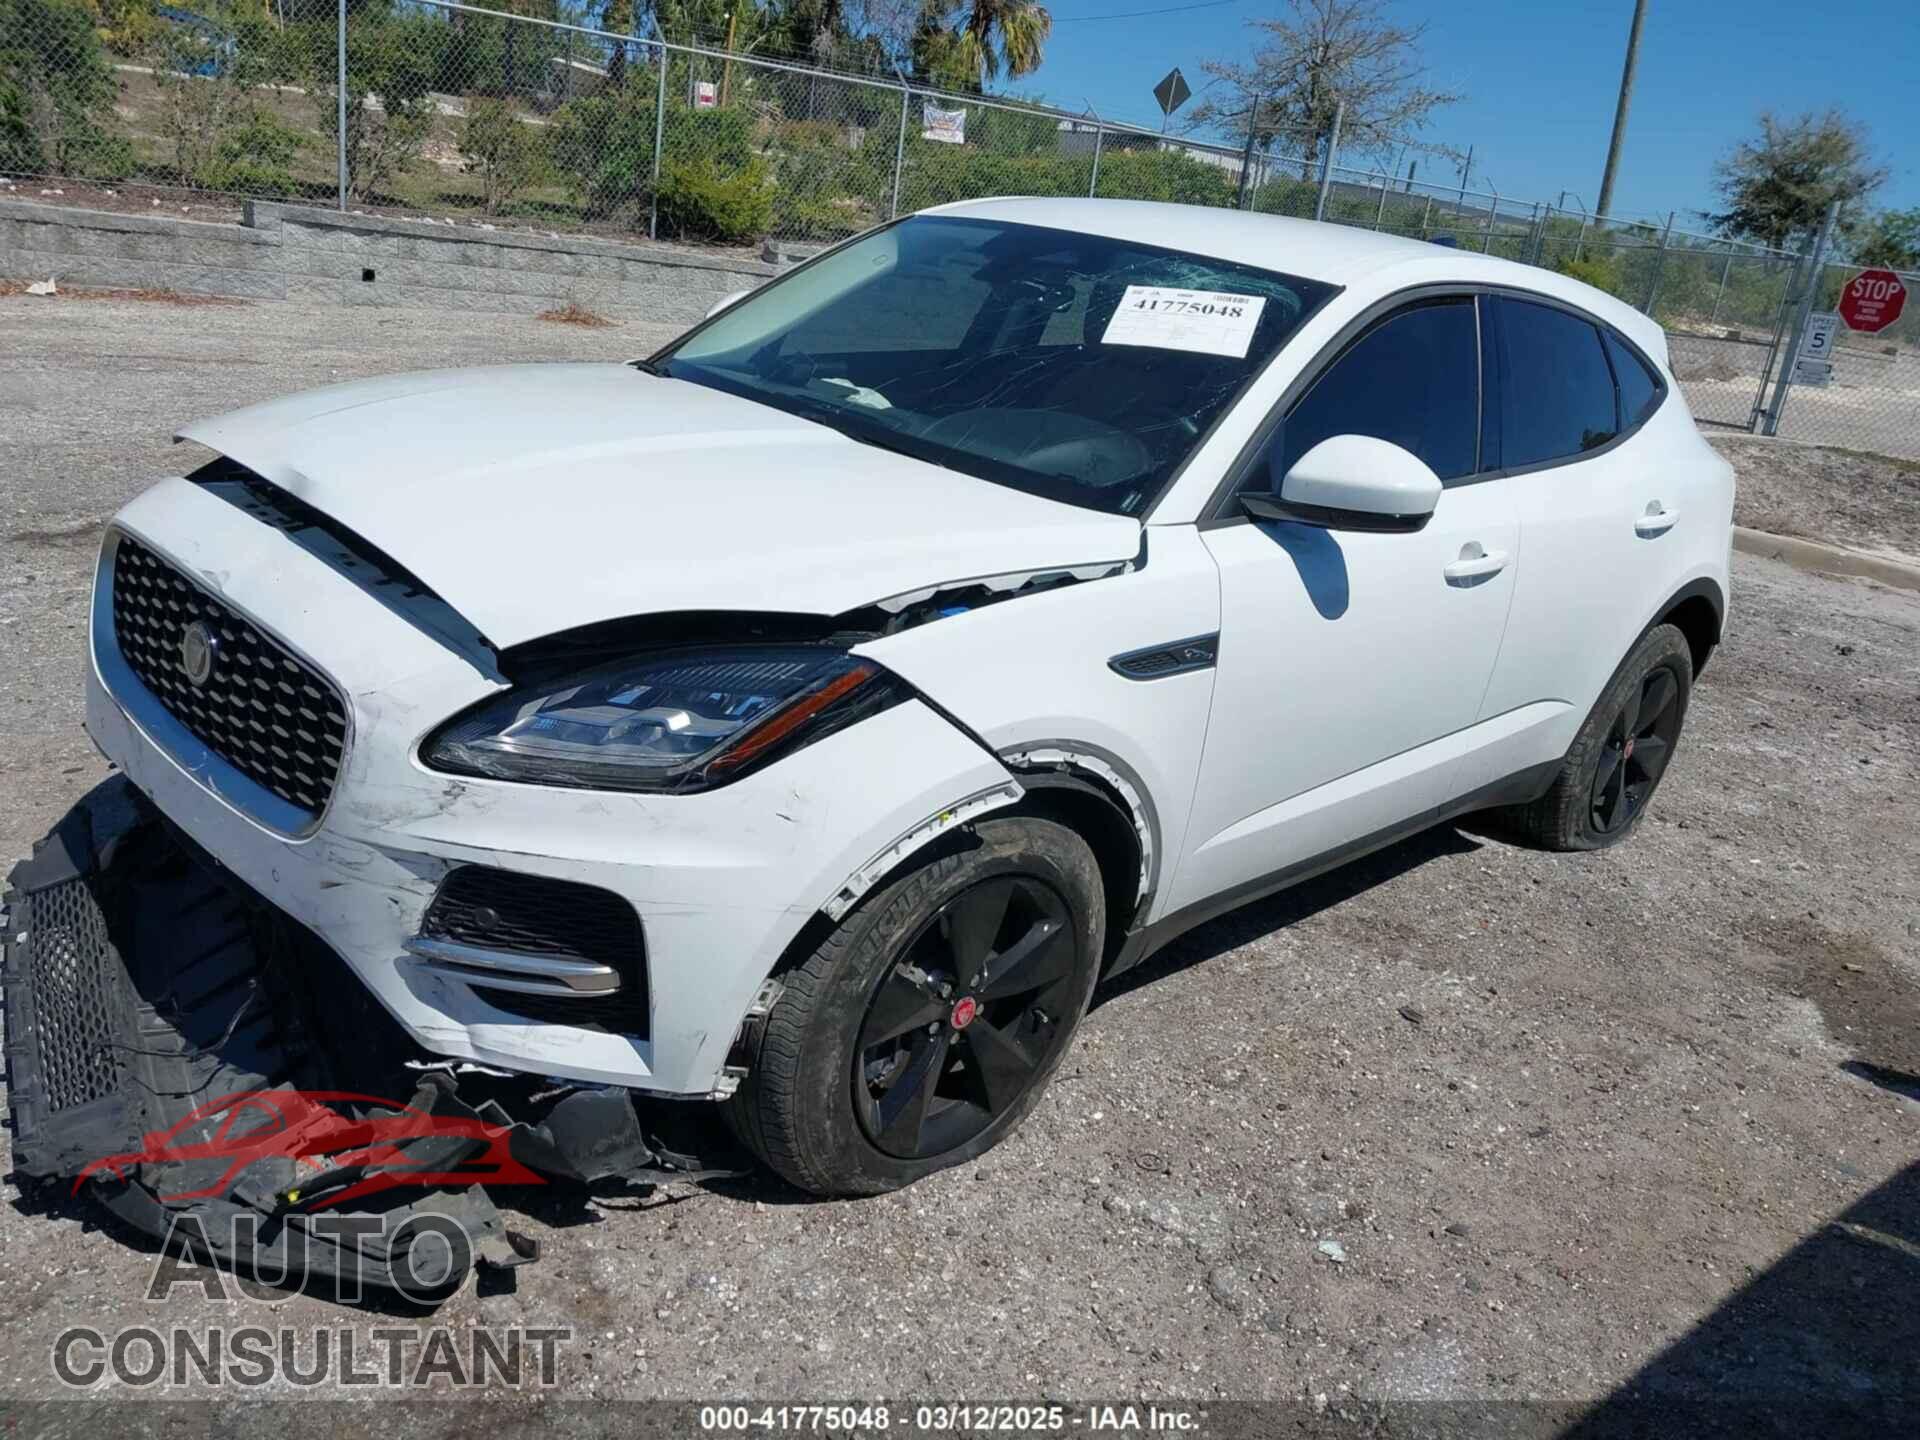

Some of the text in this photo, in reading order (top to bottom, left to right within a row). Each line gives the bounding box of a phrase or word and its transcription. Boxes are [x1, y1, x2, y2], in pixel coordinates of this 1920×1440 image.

[1852, 278, 1900, 301] STOP
[1133, 299, 1243, 318] 41775048
[1811, 332, 1826, 348] 5
